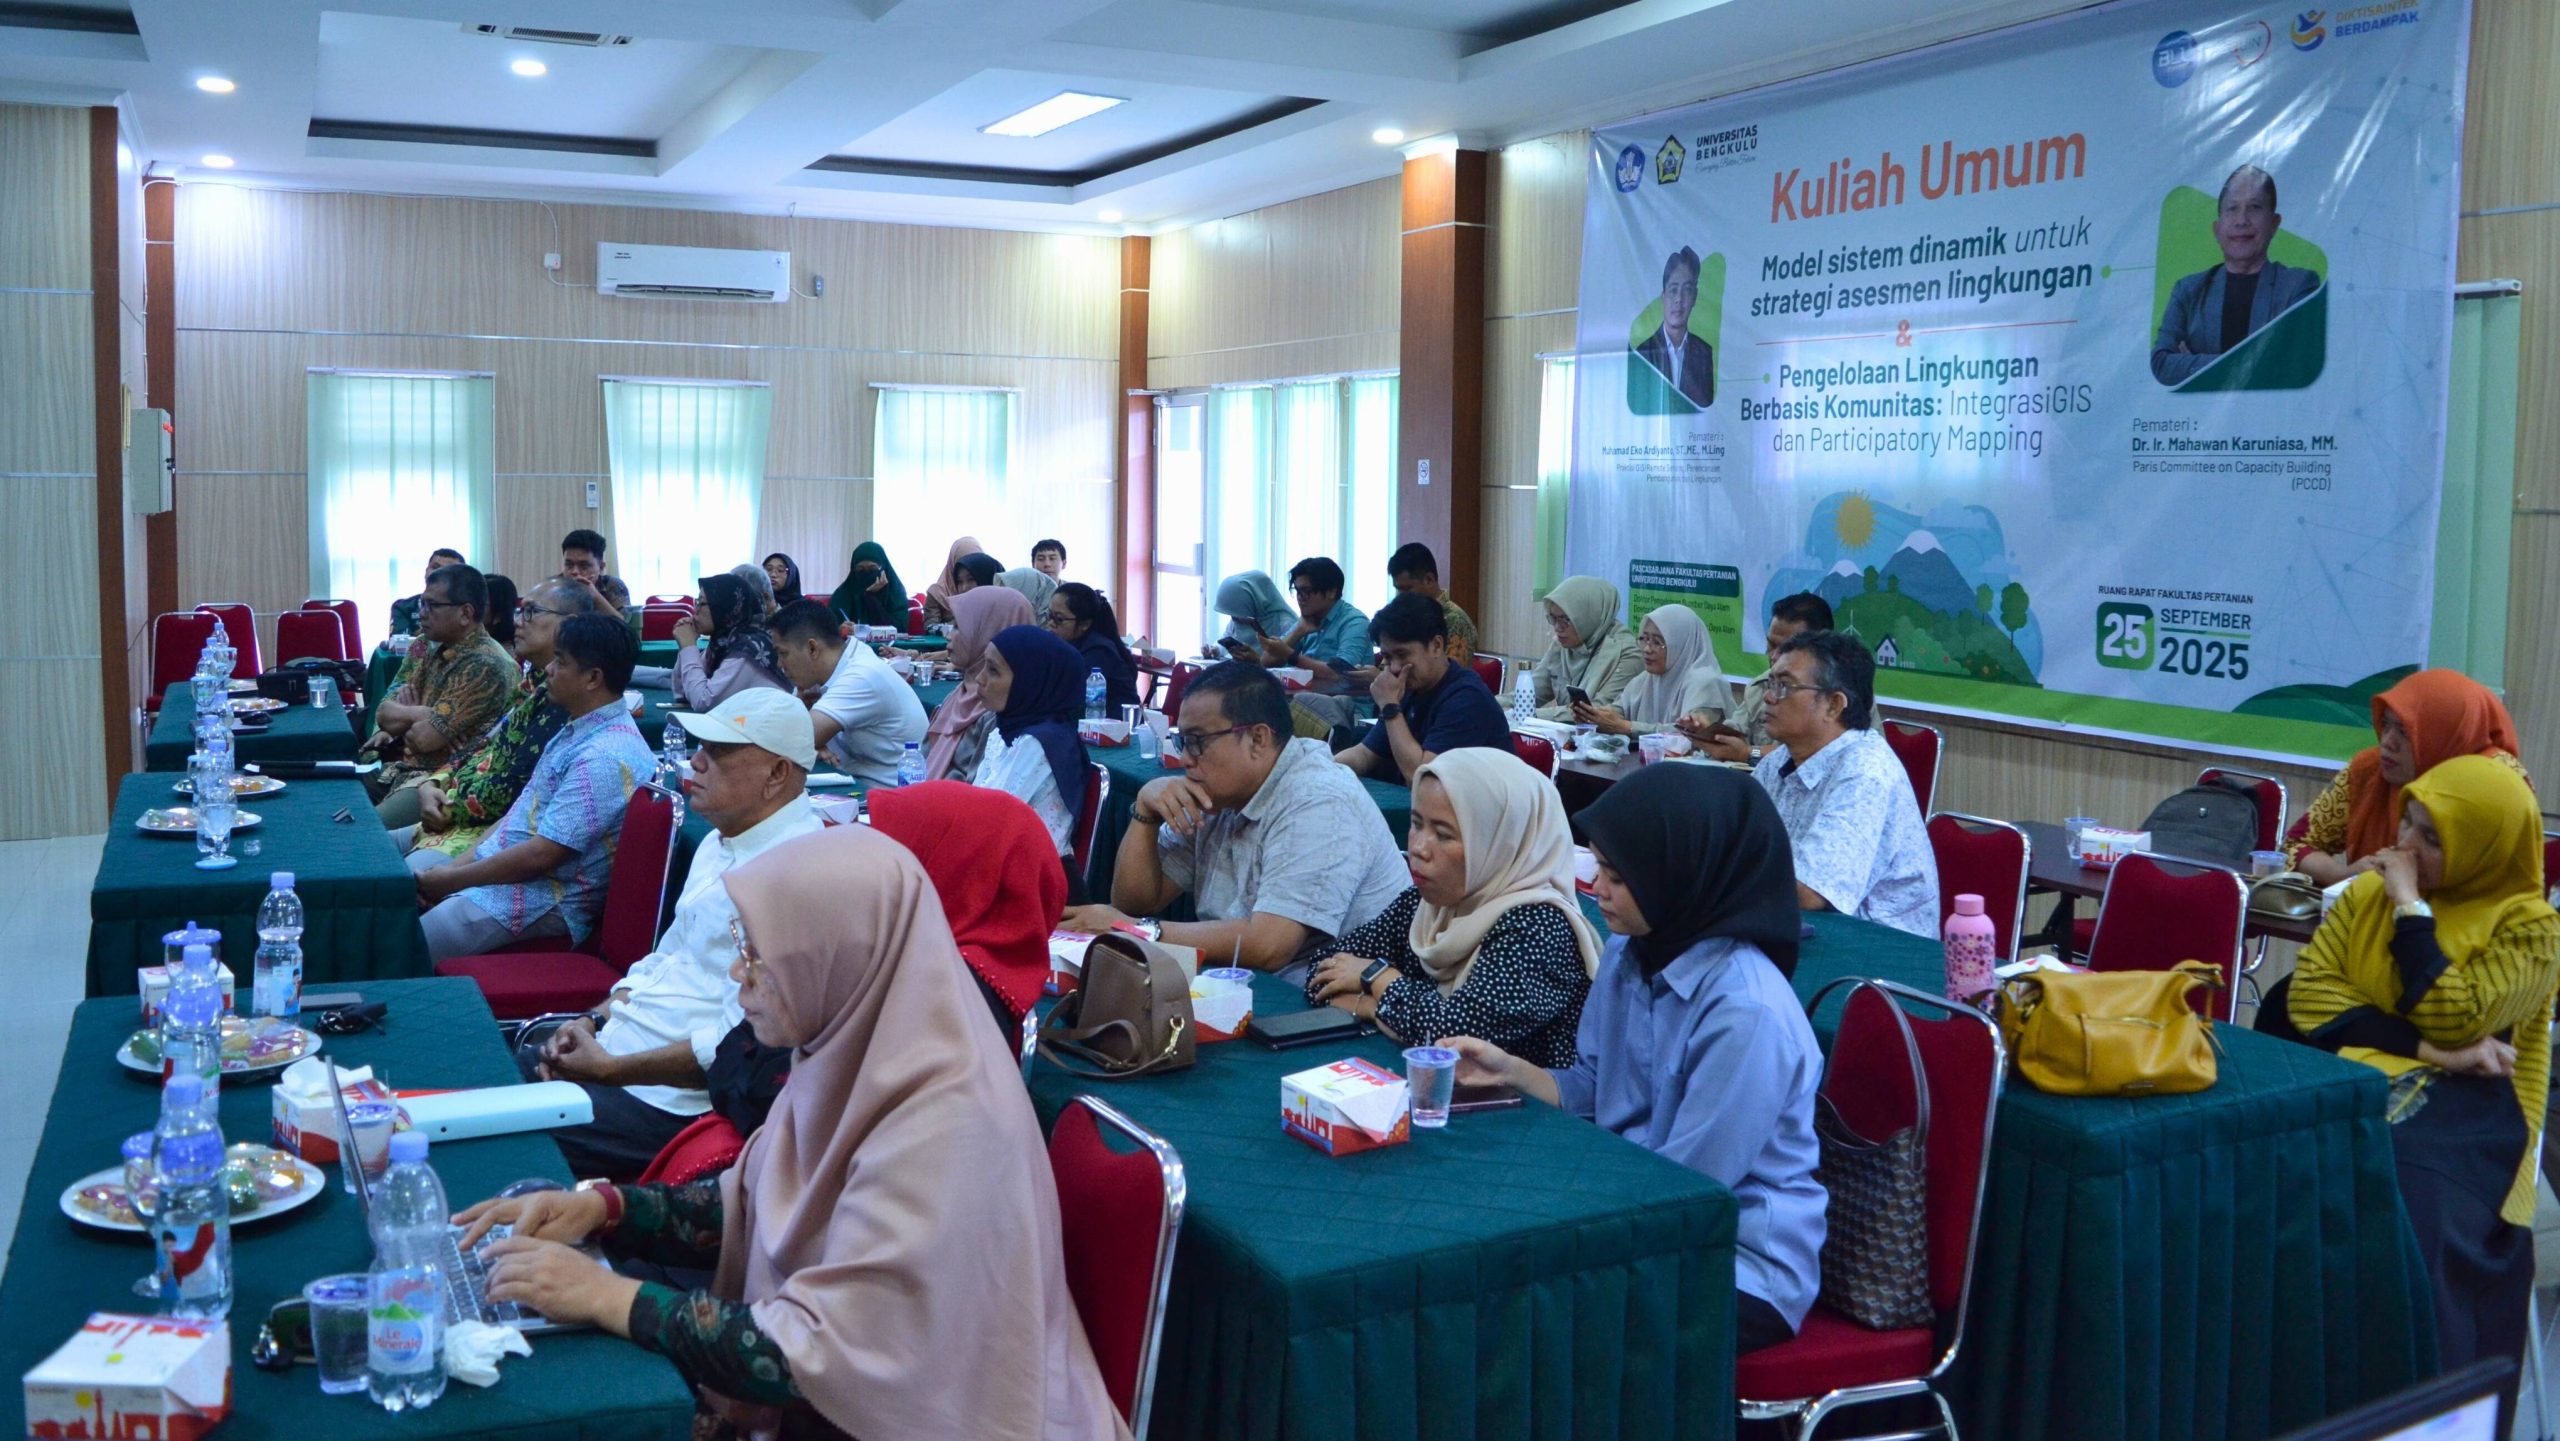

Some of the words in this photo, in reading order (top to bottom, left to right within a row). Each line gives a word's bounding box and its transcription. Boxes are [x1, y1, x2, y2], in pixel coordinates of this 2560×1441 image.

[2336, 11, 2418, 37] BERDAMPAK
[1696, 124, 1758, 148] UNIVERSITAS
[1696, 138, 1758, 160] BENGKULU
[1771, 151, 1905, 223] Kuliah
[1920, 132, 2086, 200] Umum
[1762, 249, 1823, 281] Model
[1827, 244, 1903, 274] sistem
[1909, 226, 2007, 265] dinamik
[2014, 215, 2093, 253] untuk
[1750, 283, 1833, 318] strategi
[1837, 278, 1941, 309] asesmen
[1948, 263, 2093, 303] lingkungan
[1895, 319, 1912, 347] &
[1779, 360, 1899, 392] Pengelolaan
[1905, 355, 2039, 385] Lingkungan
[1740, 393, 1819, 421] Berbasis
[1824, 391, 1942, 419] Komunitas:
[1949, 384, 2092, 422] IntegrasiGIS
[2132, 417, 2190, 432] Pemateri
[1630, 446, 1643, 455] Eko
[1773, 428, 1805, 452] dan
[1810, 424, 1941, 457] Participatory
[1947, 424, 2043, 457] Mapping
[2132, 437, 2150, 451] Dr.
[2153, 437, 2165, 451] Ir.
[2168, 437, 2228, 451] Mahawan
[2232, 436, 2307, 453] Karuniasa,
[2311, 435, 2338, 450] MM.
[2132, 461, 2158, 473] Paris
[2160, 461, 2216, 473] Committee
[2218, 463, 2232, 473] on
[2235, 461, 2284, 476] Capacity
[2286, 460, 2331, 476] Building
[2291, 477, 2331, 491] (PCCD)
[1631, 574, 1665, 585] UNIVERSITAS
[1665, 577, 1697, 588] BENGKULU
[1632, 564, 1674, 575] PASCASARJANA
[1675, 567, 1702, 578] FAKULTAS
[1703, 569, 1736, 580] PERTANIAN
[2098, 585, 2127, 596] RUANG
[2128, 587, 2156, 598] RAPAT
[2157, 589, 2203, 601] FAKULTAS
[2204, 592, 2253, 604] PERTANIAN
[2160, 608, 2252, 630] SEPTEMBER
[2102, 612, 2147, 660] 25
[2158, 636, 2249, 681] 2025
